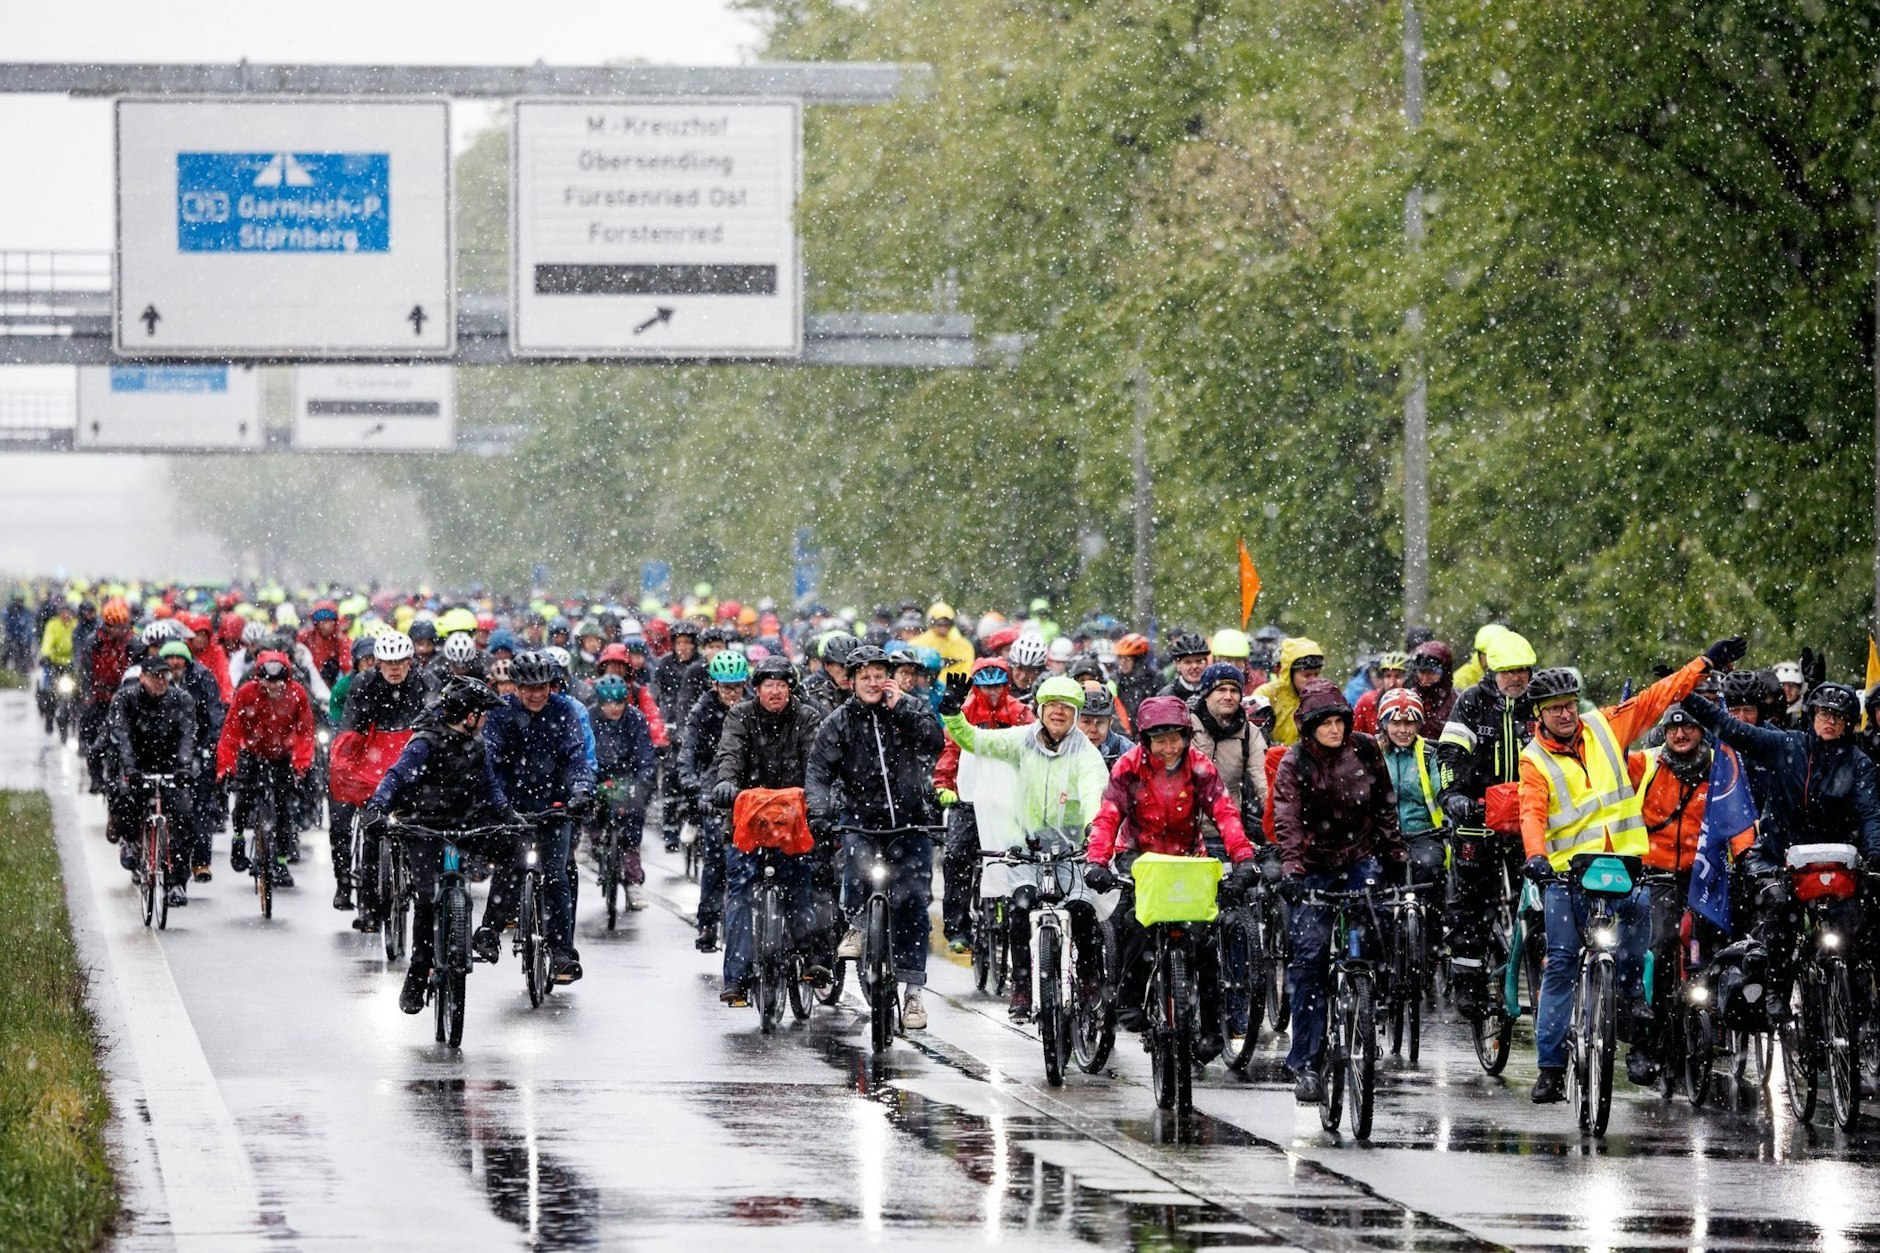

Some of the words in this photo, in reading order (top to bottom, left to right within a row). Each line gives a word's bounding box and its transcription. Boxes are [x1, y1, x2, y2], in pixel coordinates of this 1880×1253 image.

[579, 150, 733, 177] Obersendling
[564, 185, 699, 207] Fürstenried
[709, 187, 747, 207] Ost
[238, 223, 359, 252] Starnberg
[589, 221, 724, 244] Forstenried
